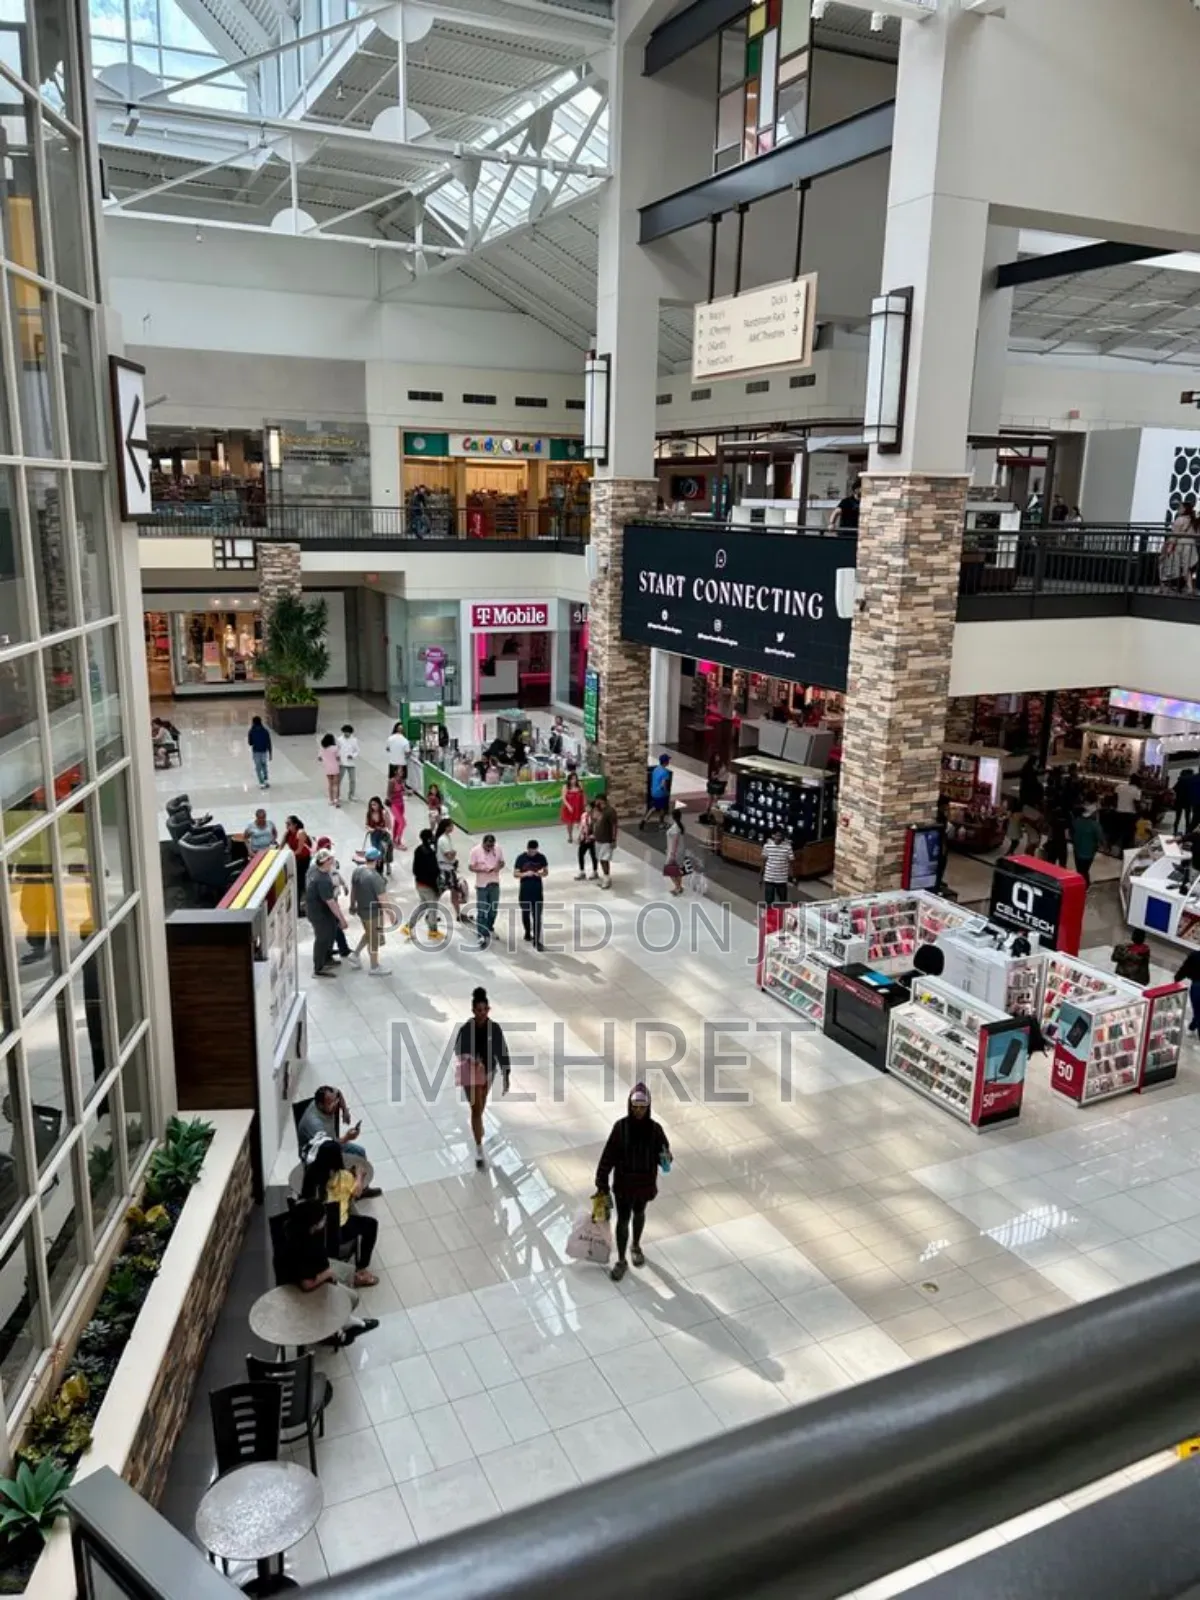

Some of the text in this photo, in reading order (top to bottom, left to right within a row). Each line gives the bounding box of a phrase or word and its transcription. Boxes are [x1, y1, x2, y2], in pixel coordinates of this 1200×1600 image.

[463, 437, 542, 455] Candy Land
[638, 570, 824, 620] START CONNECTING
[493, 606, 545, 624] Mobile
